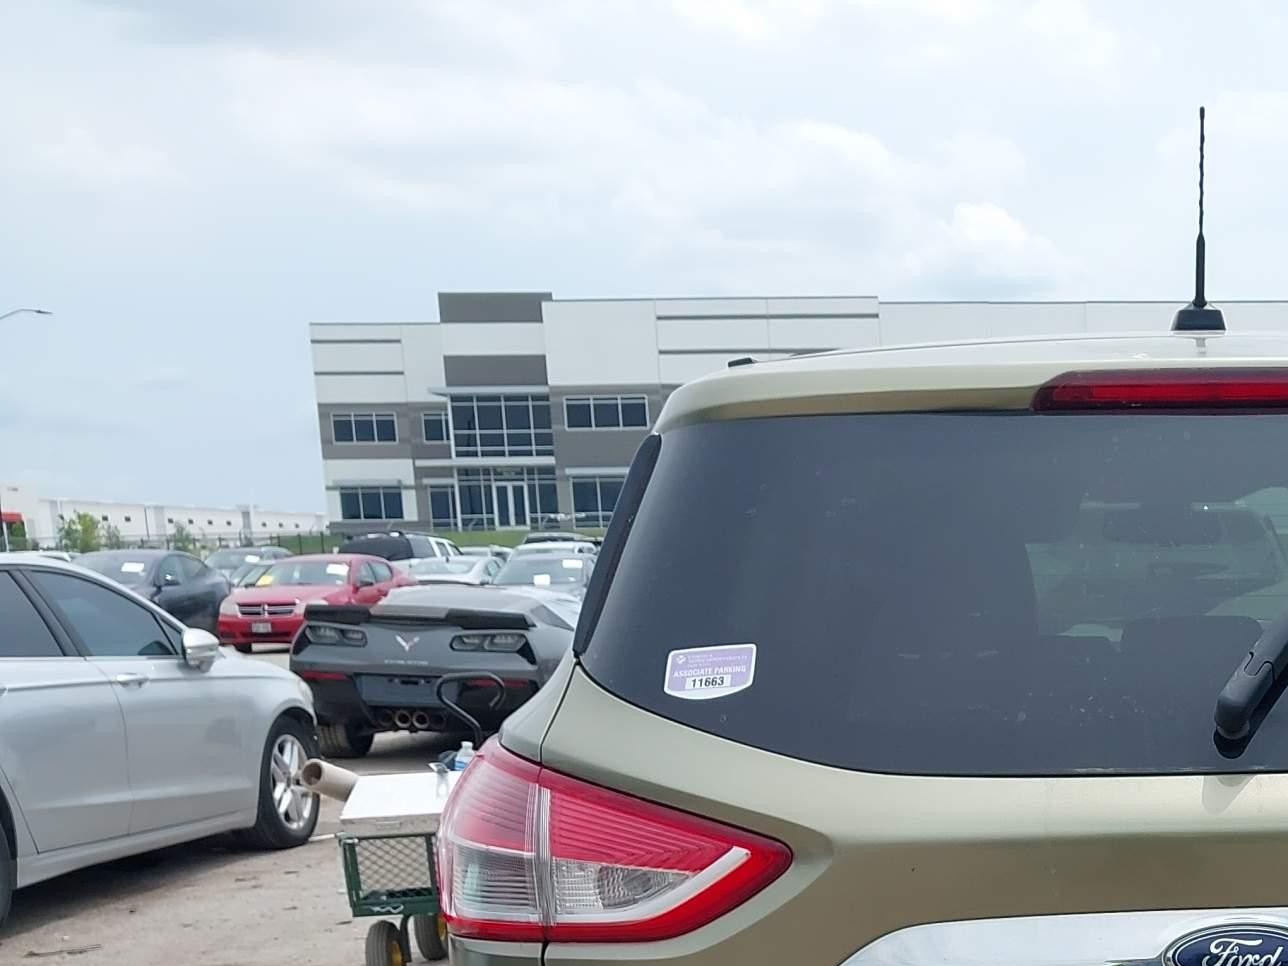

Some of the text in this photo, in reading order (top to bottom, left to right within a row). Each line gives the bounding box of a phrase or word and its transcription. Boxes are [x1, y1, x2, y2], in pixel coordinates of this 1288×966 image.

[673, 665, 746, 677] ASSOCIATE PARKING
[691, 676, 725, 688] 11663
